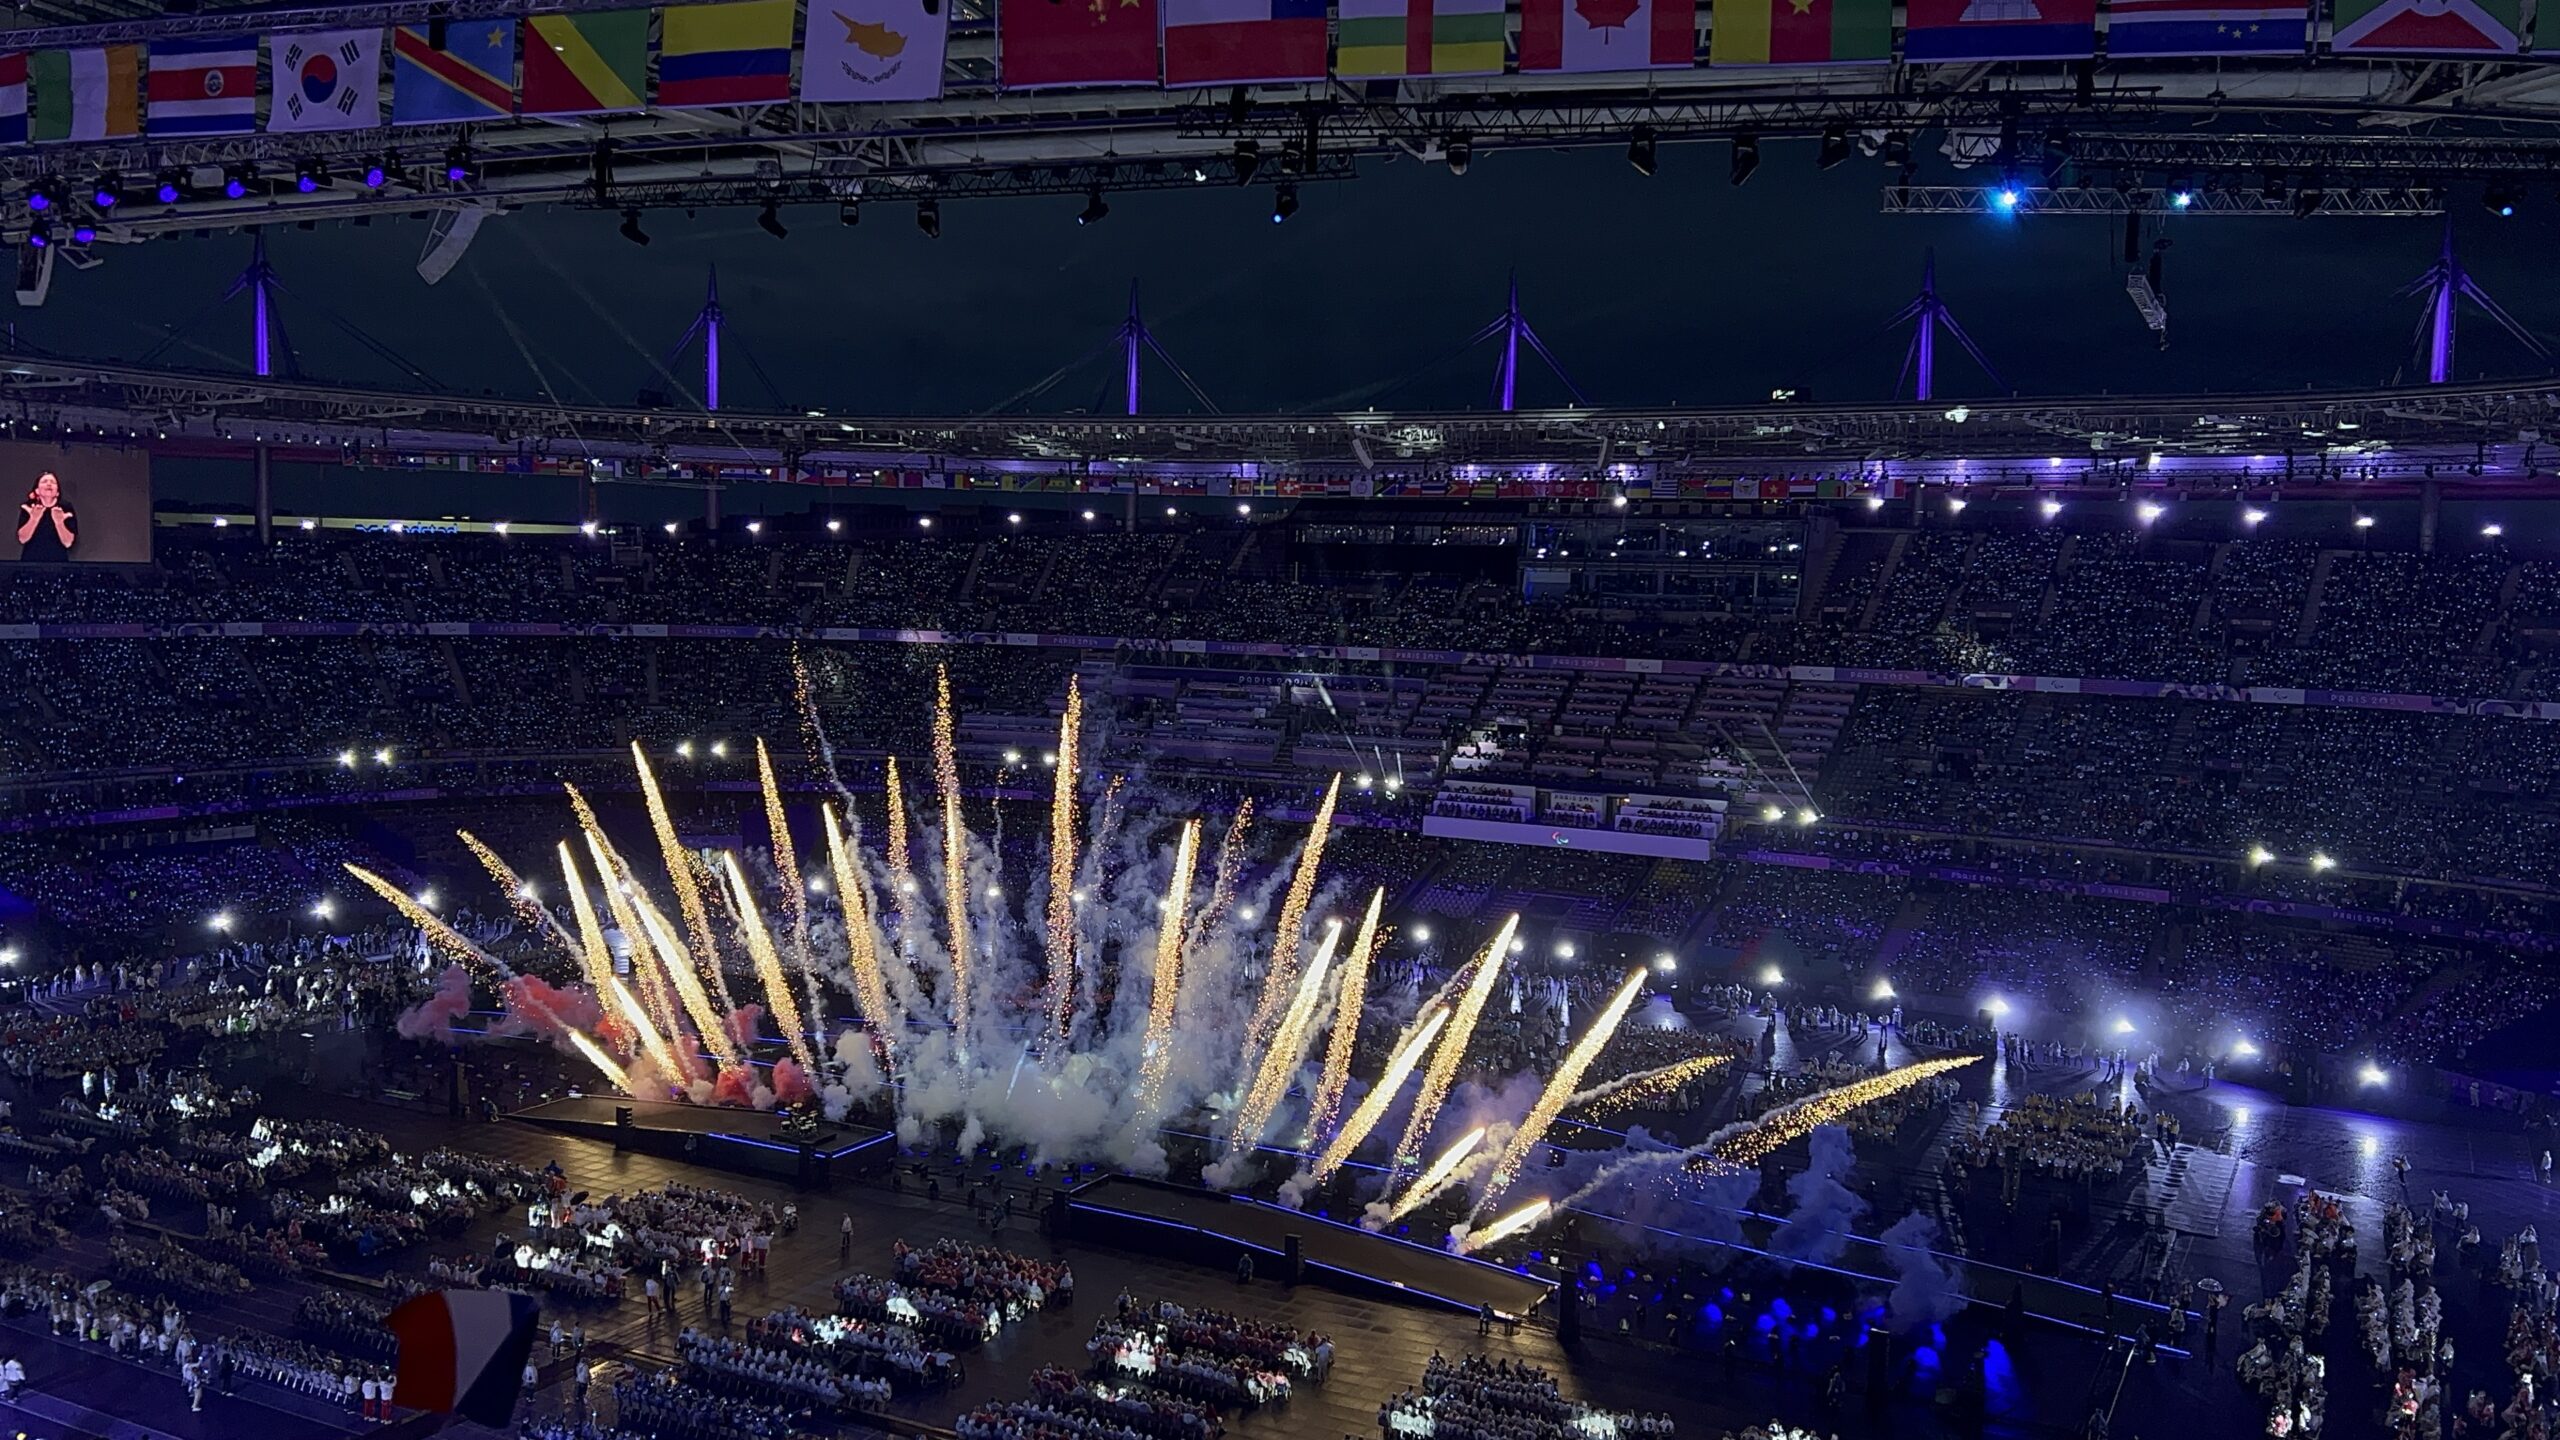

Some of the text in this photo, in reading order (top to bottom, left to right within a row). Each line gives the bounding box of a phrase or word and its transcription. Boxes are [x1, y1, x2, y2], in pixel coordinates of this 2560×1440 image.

[2331, 694, 2405, 706] PARIS 2024
[2333, 911, 2362, 922] PARIS
